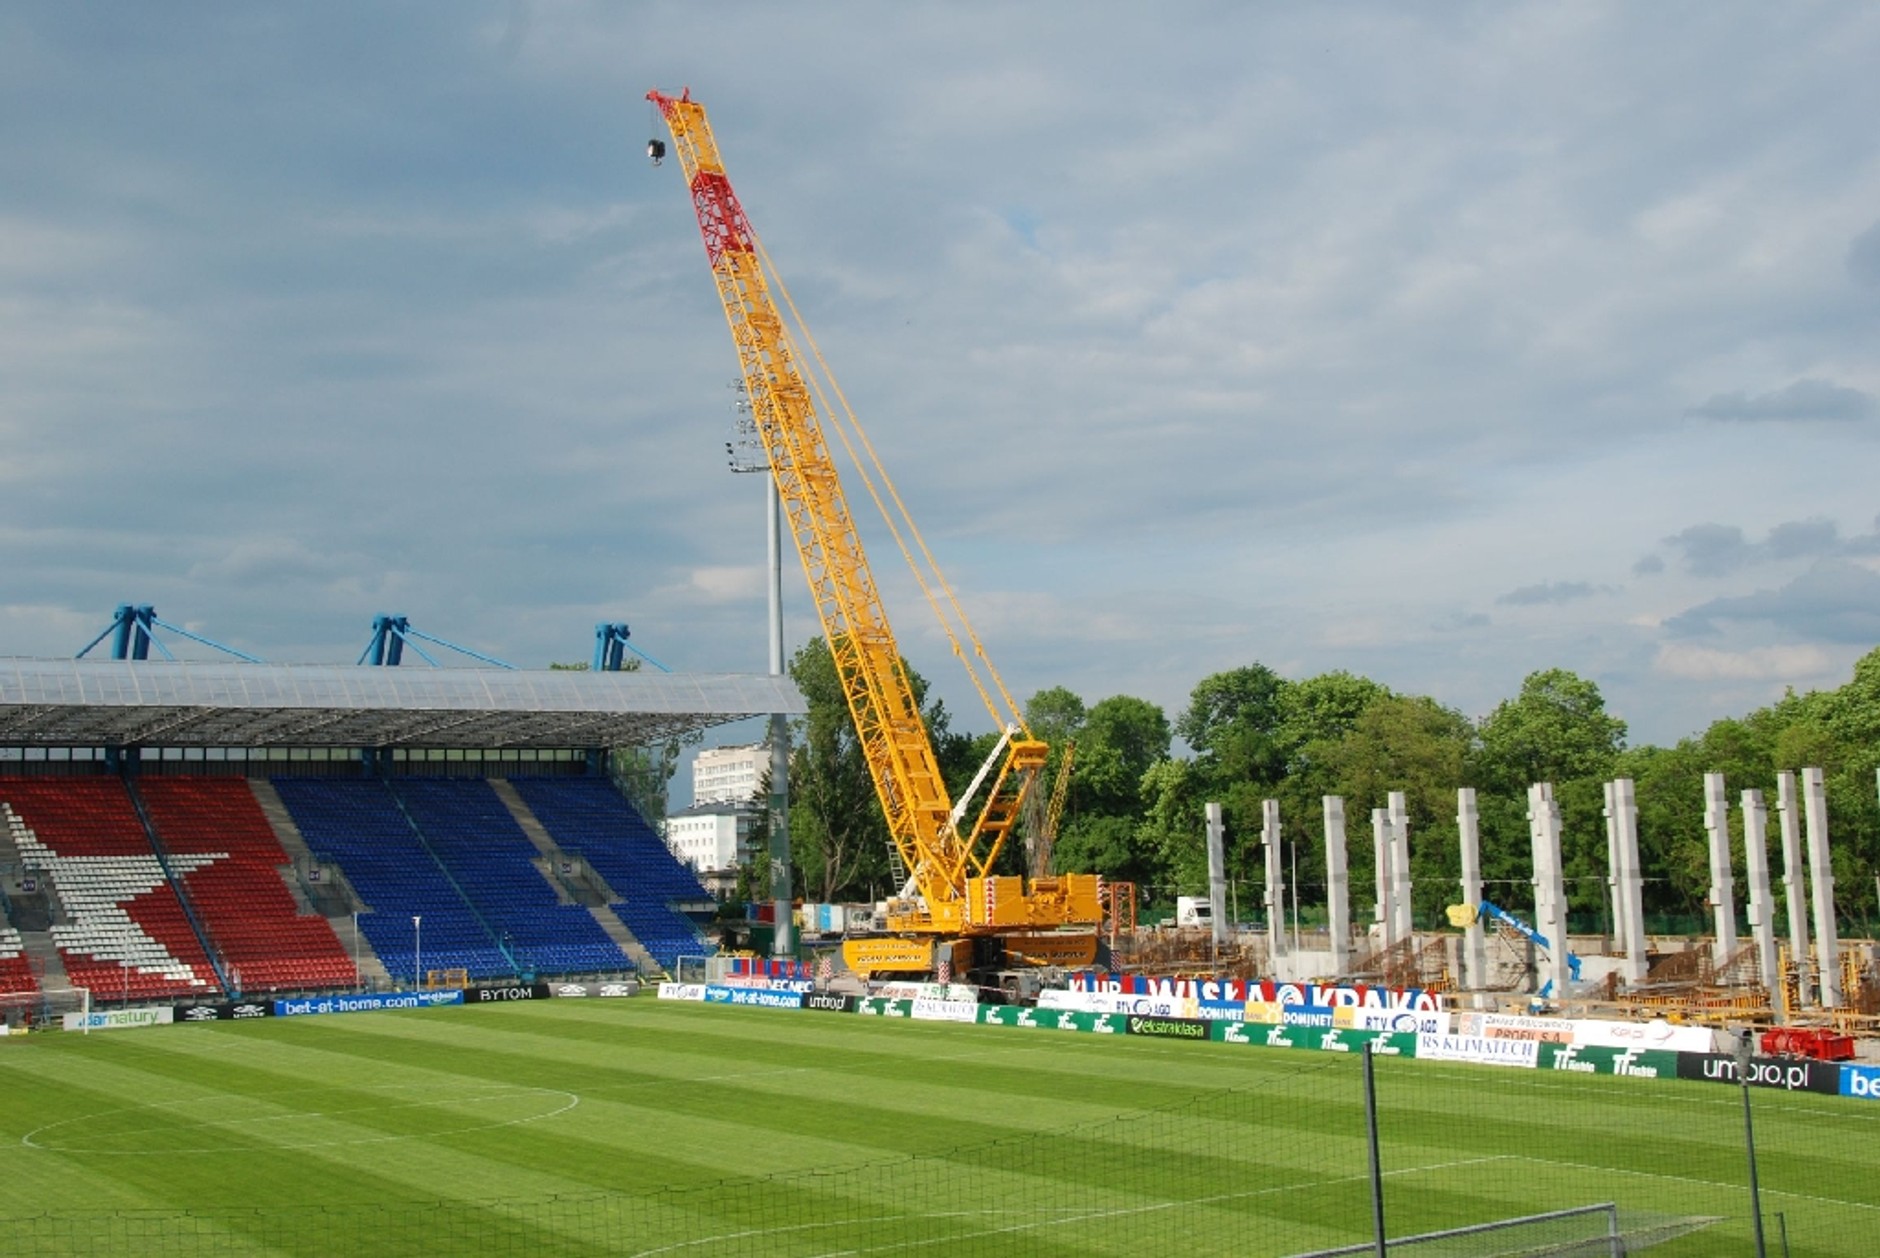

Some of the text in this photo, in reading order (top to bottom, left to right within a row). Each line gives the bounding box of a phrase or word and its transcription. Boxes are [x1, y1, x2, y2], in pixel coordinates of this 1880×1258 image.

[480, 987, 533, 1001] BYTOM
[285, 996, 418, 1015] bet-at-home.com
[1142, 1014, 1204, 1037] ekstraklasa
[1283, 1011, 1333, 1028] DOMINET
[1422, 1036, 1534, 1057] RS KLIMATECH
